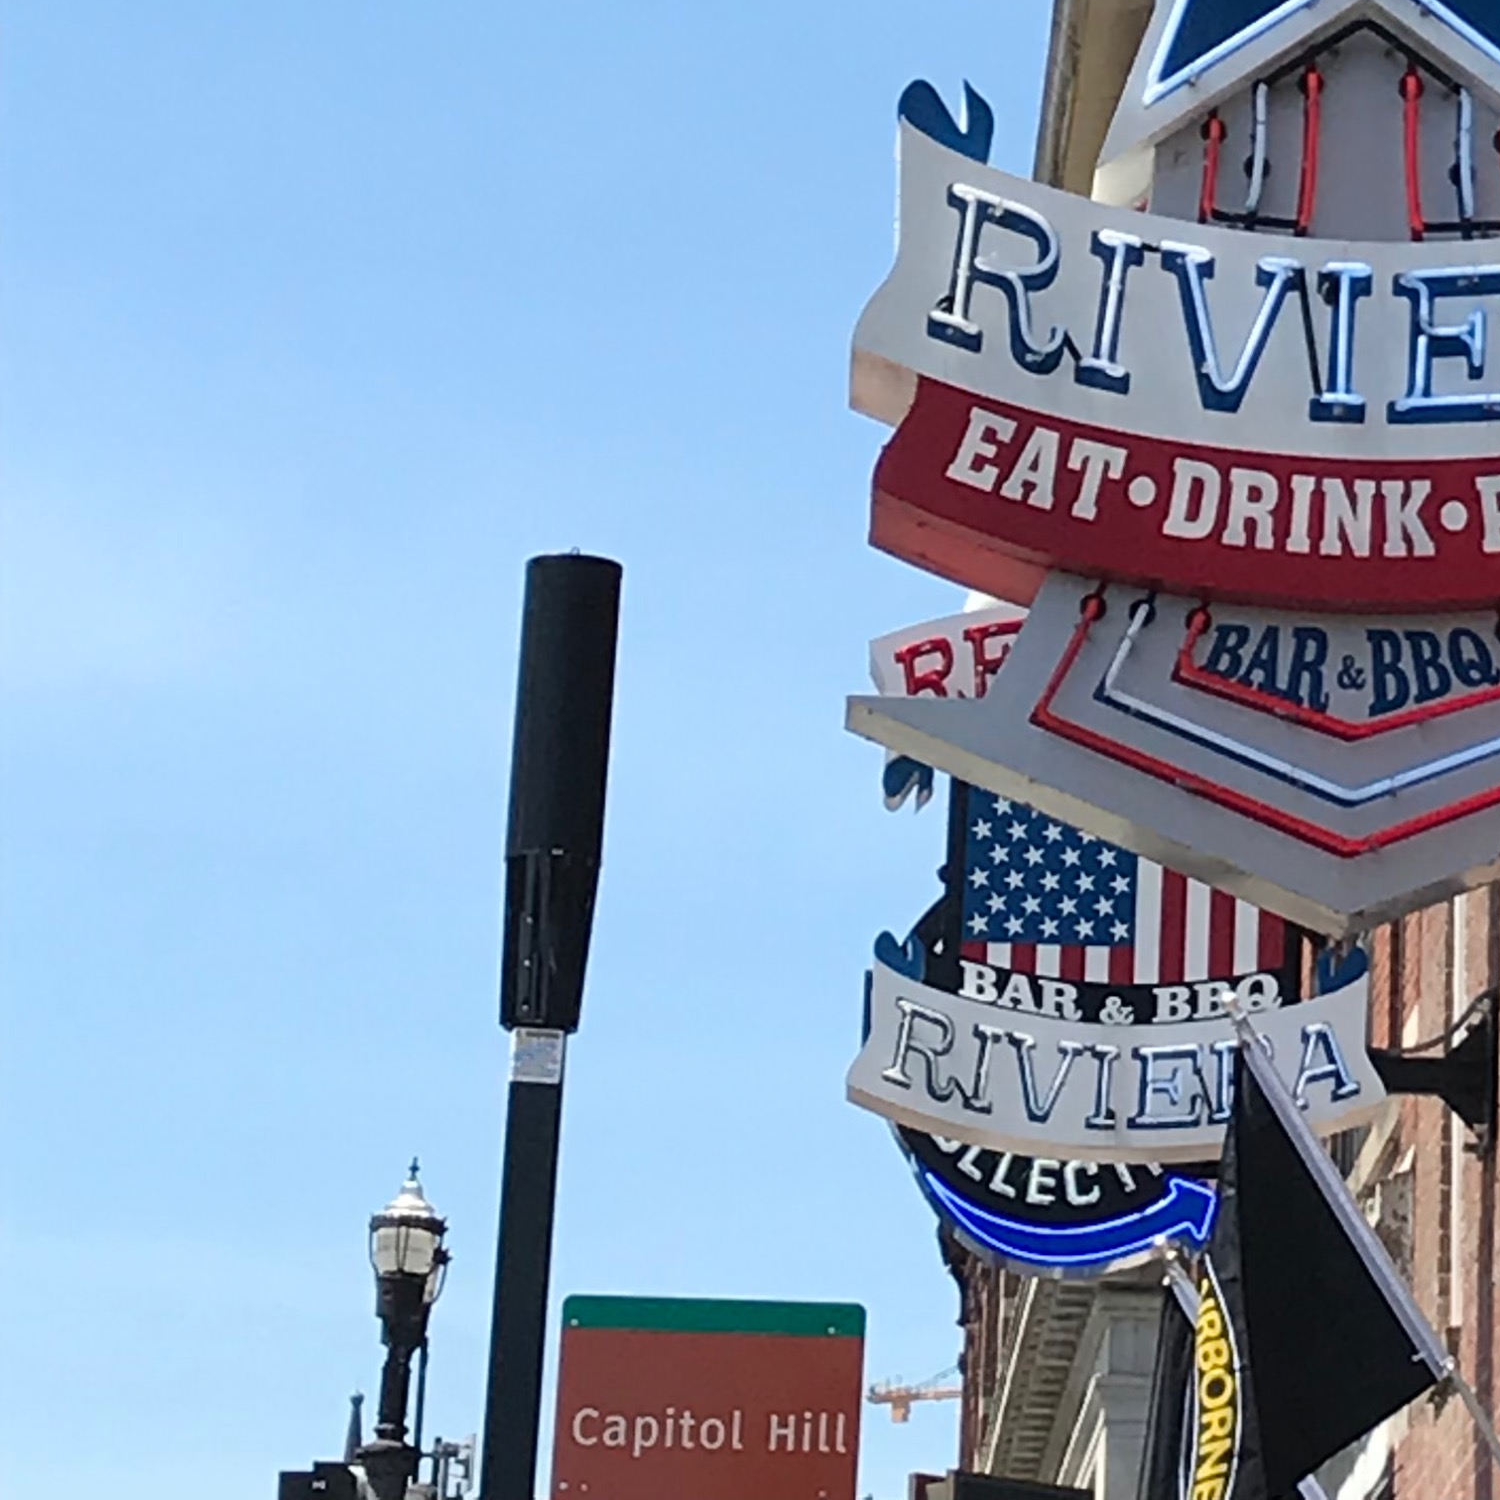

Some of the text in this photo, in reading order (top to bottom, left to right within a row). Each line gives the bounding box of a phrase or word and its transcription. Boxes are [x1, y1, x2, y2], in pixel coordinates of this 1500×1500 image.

[1205, 623, 1330, 714] BAR
[1336, 654, 1367, 691] &
[957, 959, 1284, 1026] BAR & BBQ
[571, 1407, 848, 1458] Capitol Hill
